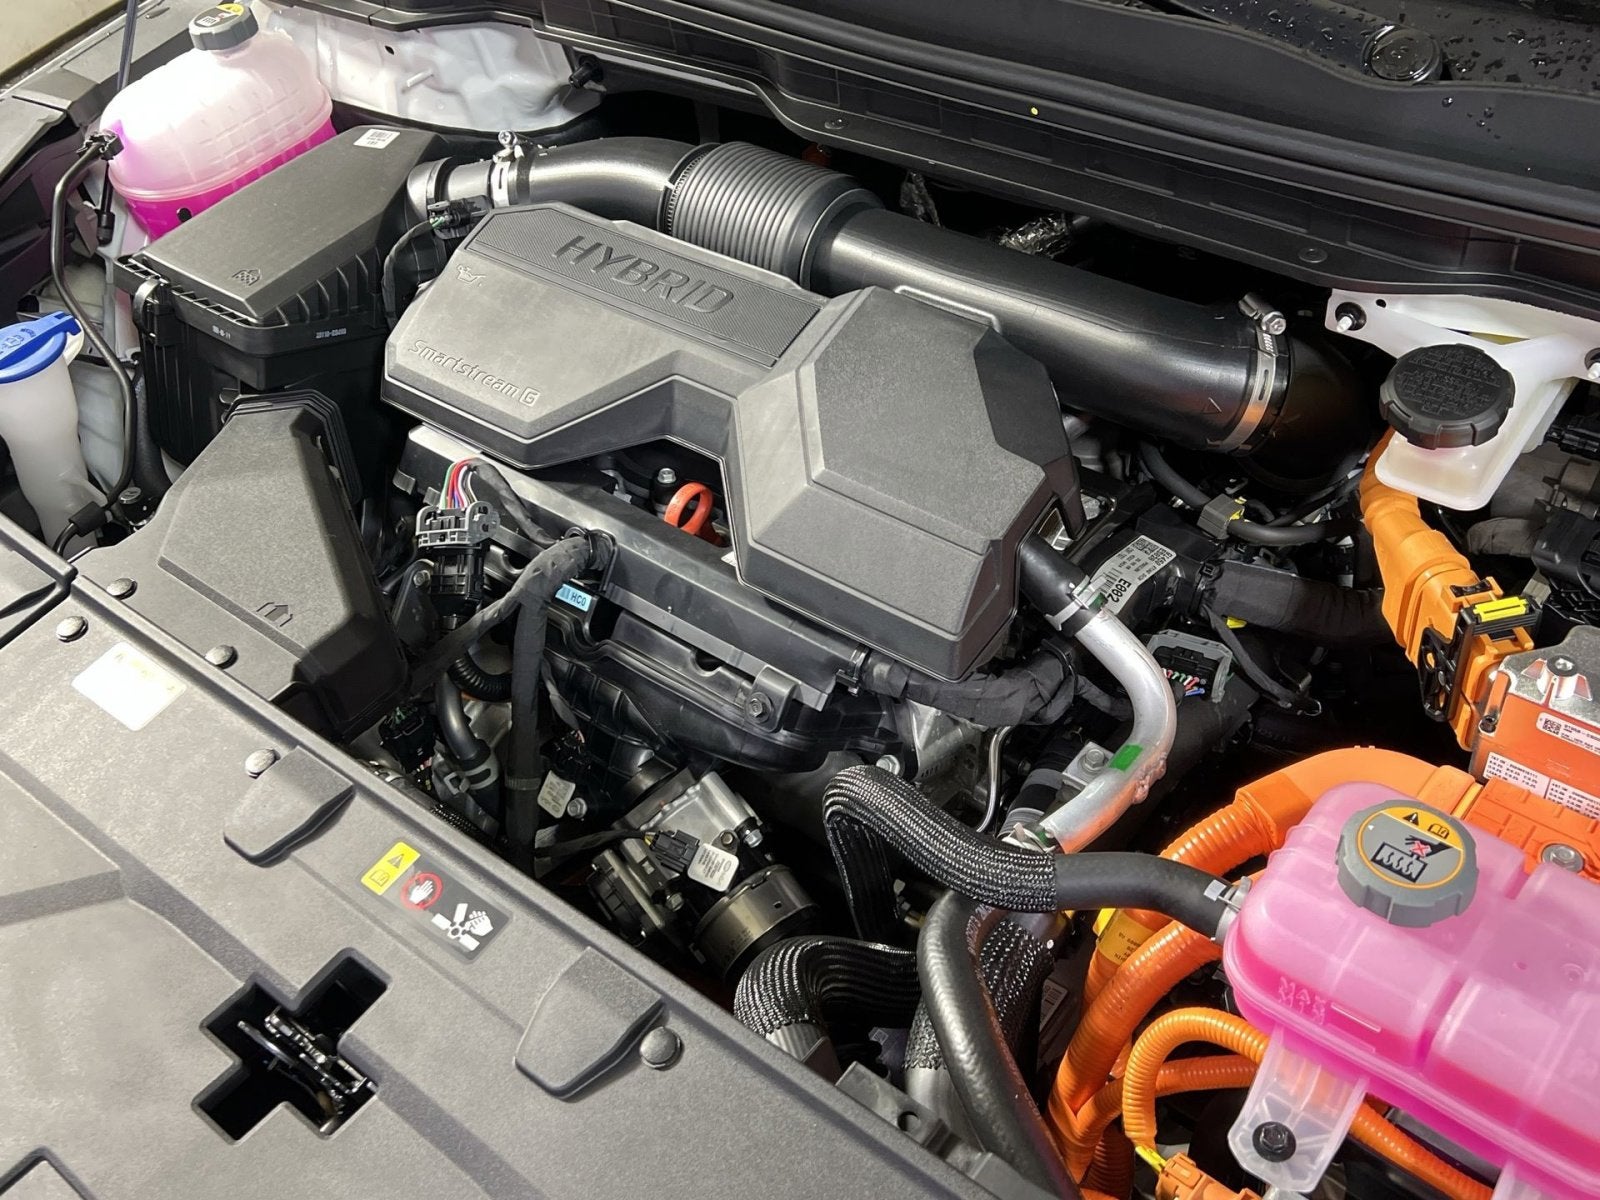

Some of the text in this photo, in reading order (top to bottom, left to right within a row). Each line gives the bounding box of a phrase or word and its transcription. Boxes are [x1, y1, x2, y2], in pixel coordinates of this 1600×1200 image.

[552, 235, 734, 313] HYBRID
[408, 339, 541, 407] Smartstream G
[1107, 578, 1132, 603] E002
